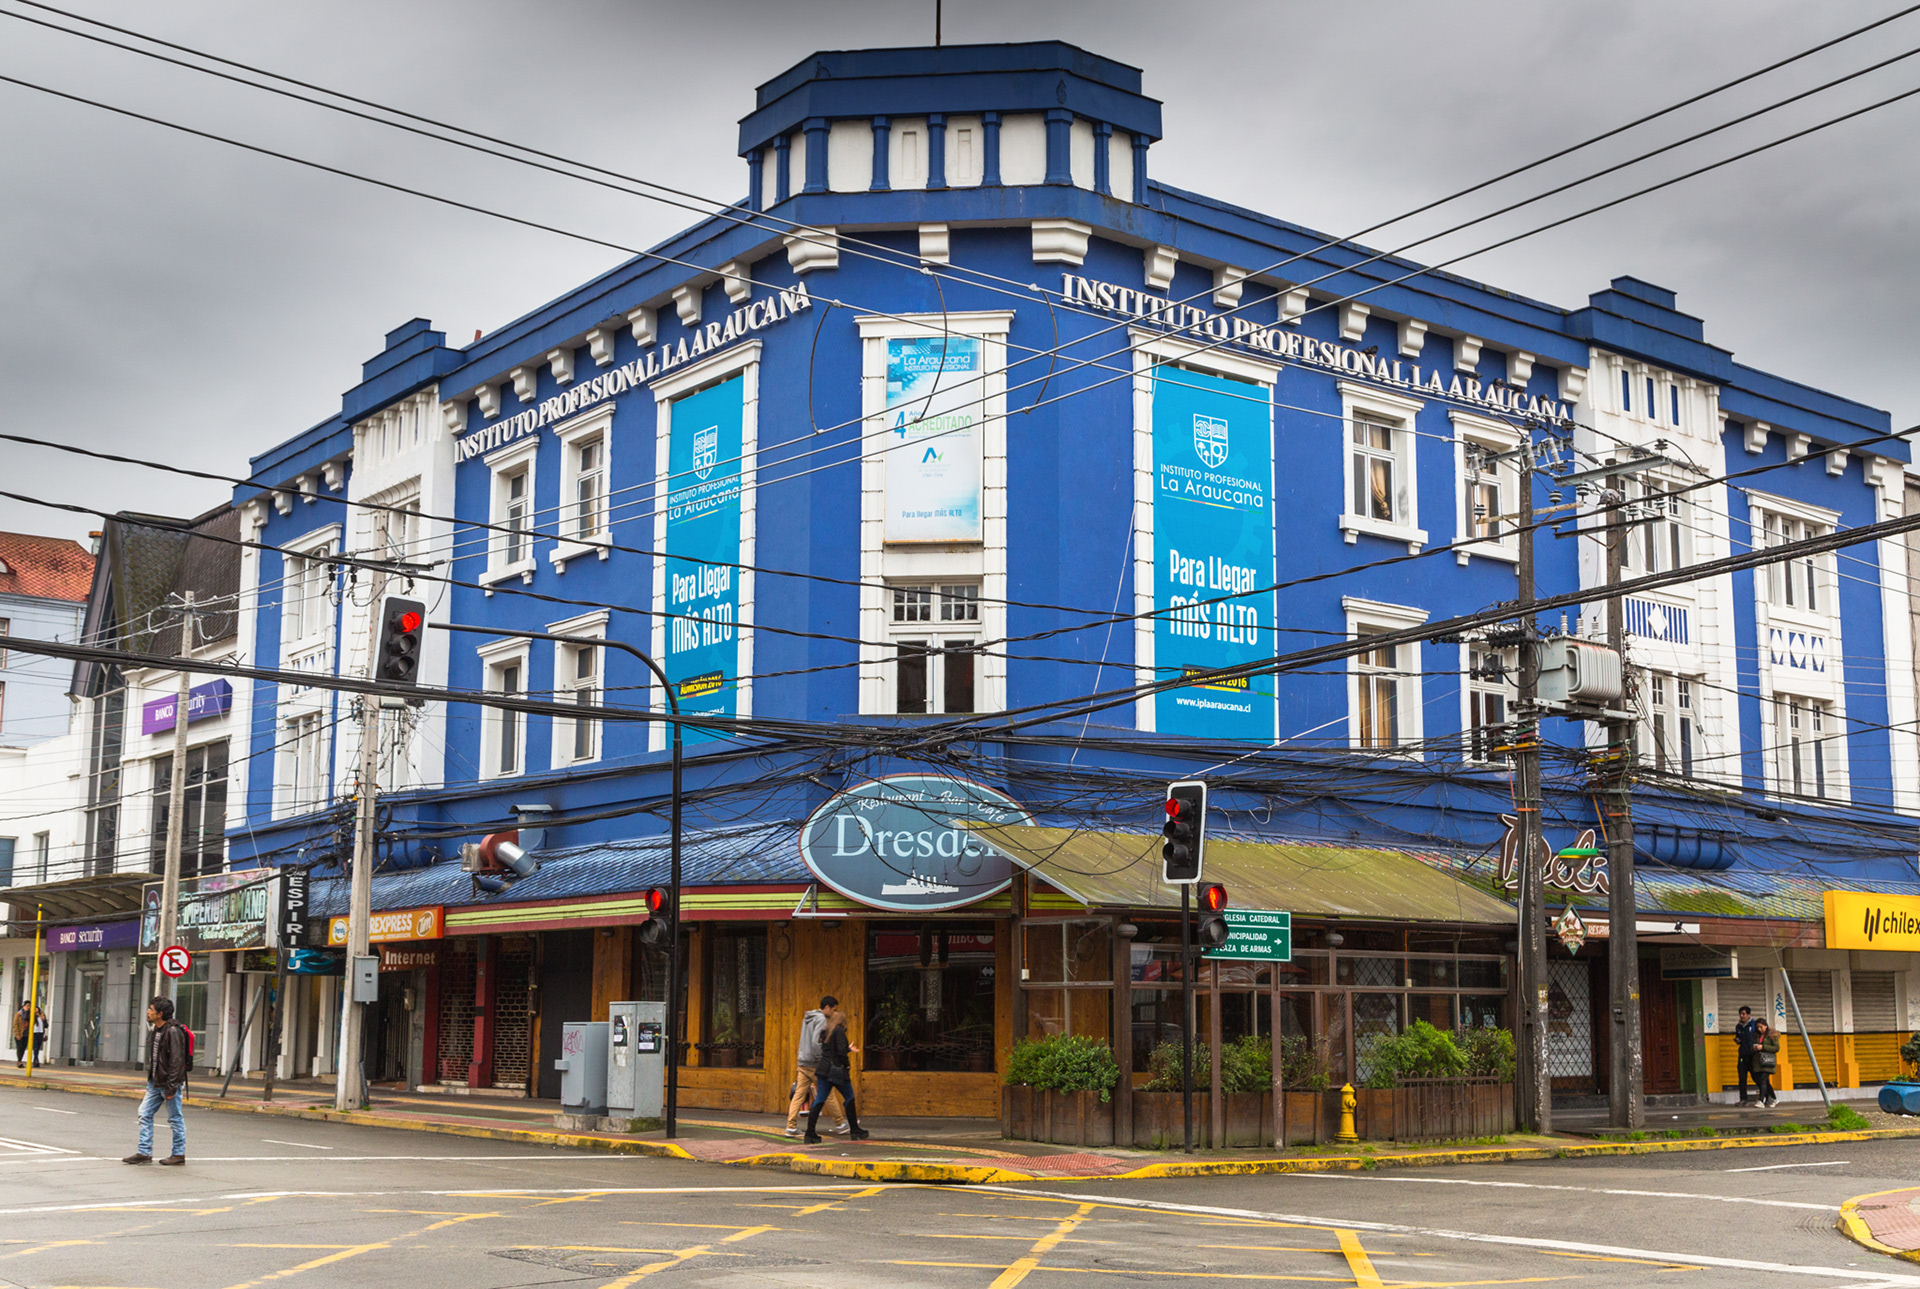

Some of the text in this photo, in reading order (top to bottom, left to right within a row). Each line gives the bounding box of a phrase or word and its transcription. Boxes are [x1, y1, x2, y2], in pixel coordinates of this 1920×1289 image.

[904, 355, 970, 366] La Araucana
[1061, 273, 1574, 427] INSTITUTO PROFESIONAL LA ARAUCANA
[454, 281, 812, 464] INSTITUTO PROFESIONAL LA ARAUCANA
[894, 411, 906, 439] 4
[669, 476, 740, 505] INSTITUTO PROFESIONAL
[1160, 463, 1263, 491] INSTITUTO PROFESIONAL
[1161, 473, 1263, 507] La Araucana
[669, 486, 740, 520] La Araucana
[902, 510, 915, 518] Para
[948, 509, 962, 517] ALTO
[672, 564, 731, 605] Para Llegar
[1170, 549, 1257, 598] Para Llegar
[702, 602, 732, 646] ALTO
[1216, 602, 1257, 646] ALTO
[155, 692, 206, 721] BANCO urity
[1176, 698, 1251, 713] www.iplaaraucana.cl
[977, 799, 1008, 822] Café
[222, 889, 266, 922] ROMANO
[1223, 913, 1280, 924] GLESIA CATEDRAL
[60, 927, 104, 948] BANCO security
[285, 876, 304, 970] ESPIRITU
[169, 952, 181, 971] E
[385, 951, 435, 965] Internet
[1240, 944, 1249, 953] DE
[1249, 945, 1272, 953] ARMAS
